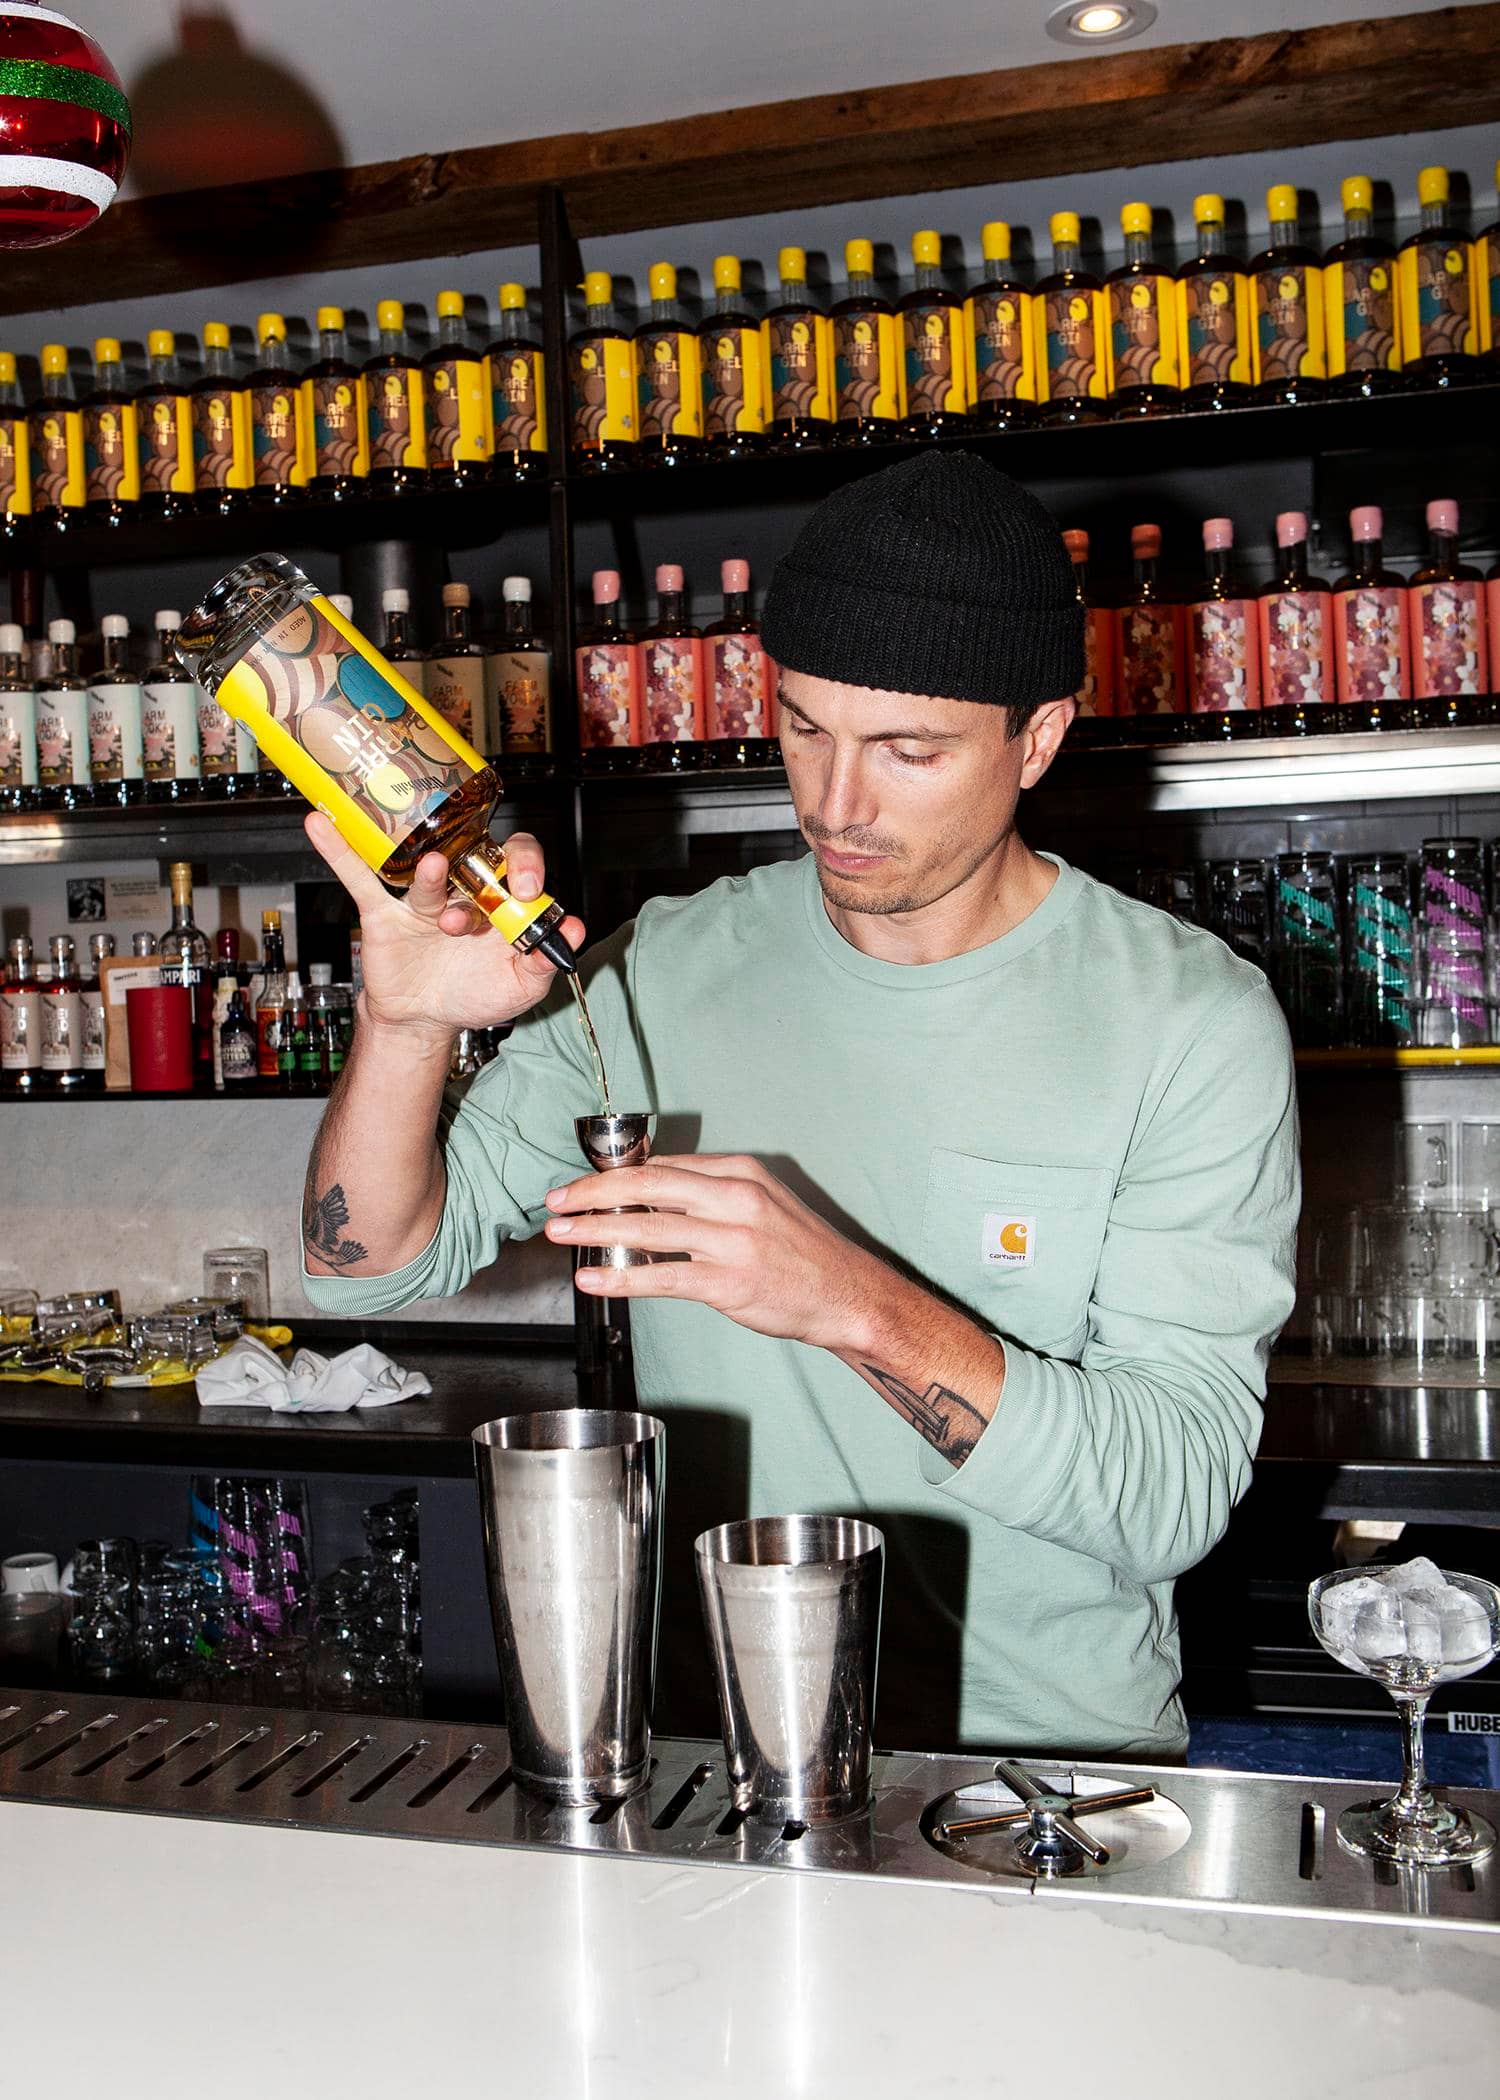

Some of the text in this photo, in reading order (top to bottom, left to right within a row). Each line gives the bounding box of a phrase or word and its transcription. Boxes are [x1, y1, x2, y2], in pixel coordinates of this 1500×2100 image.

[289, 615, 307, 632] AGED
[331, 703, 387, 757] GIN
[159, 969, 201, 985] AMPARI
[989, 1253, 1026, 1261] carhartt
[1455, 1714, 1500, 1733] HUBE
